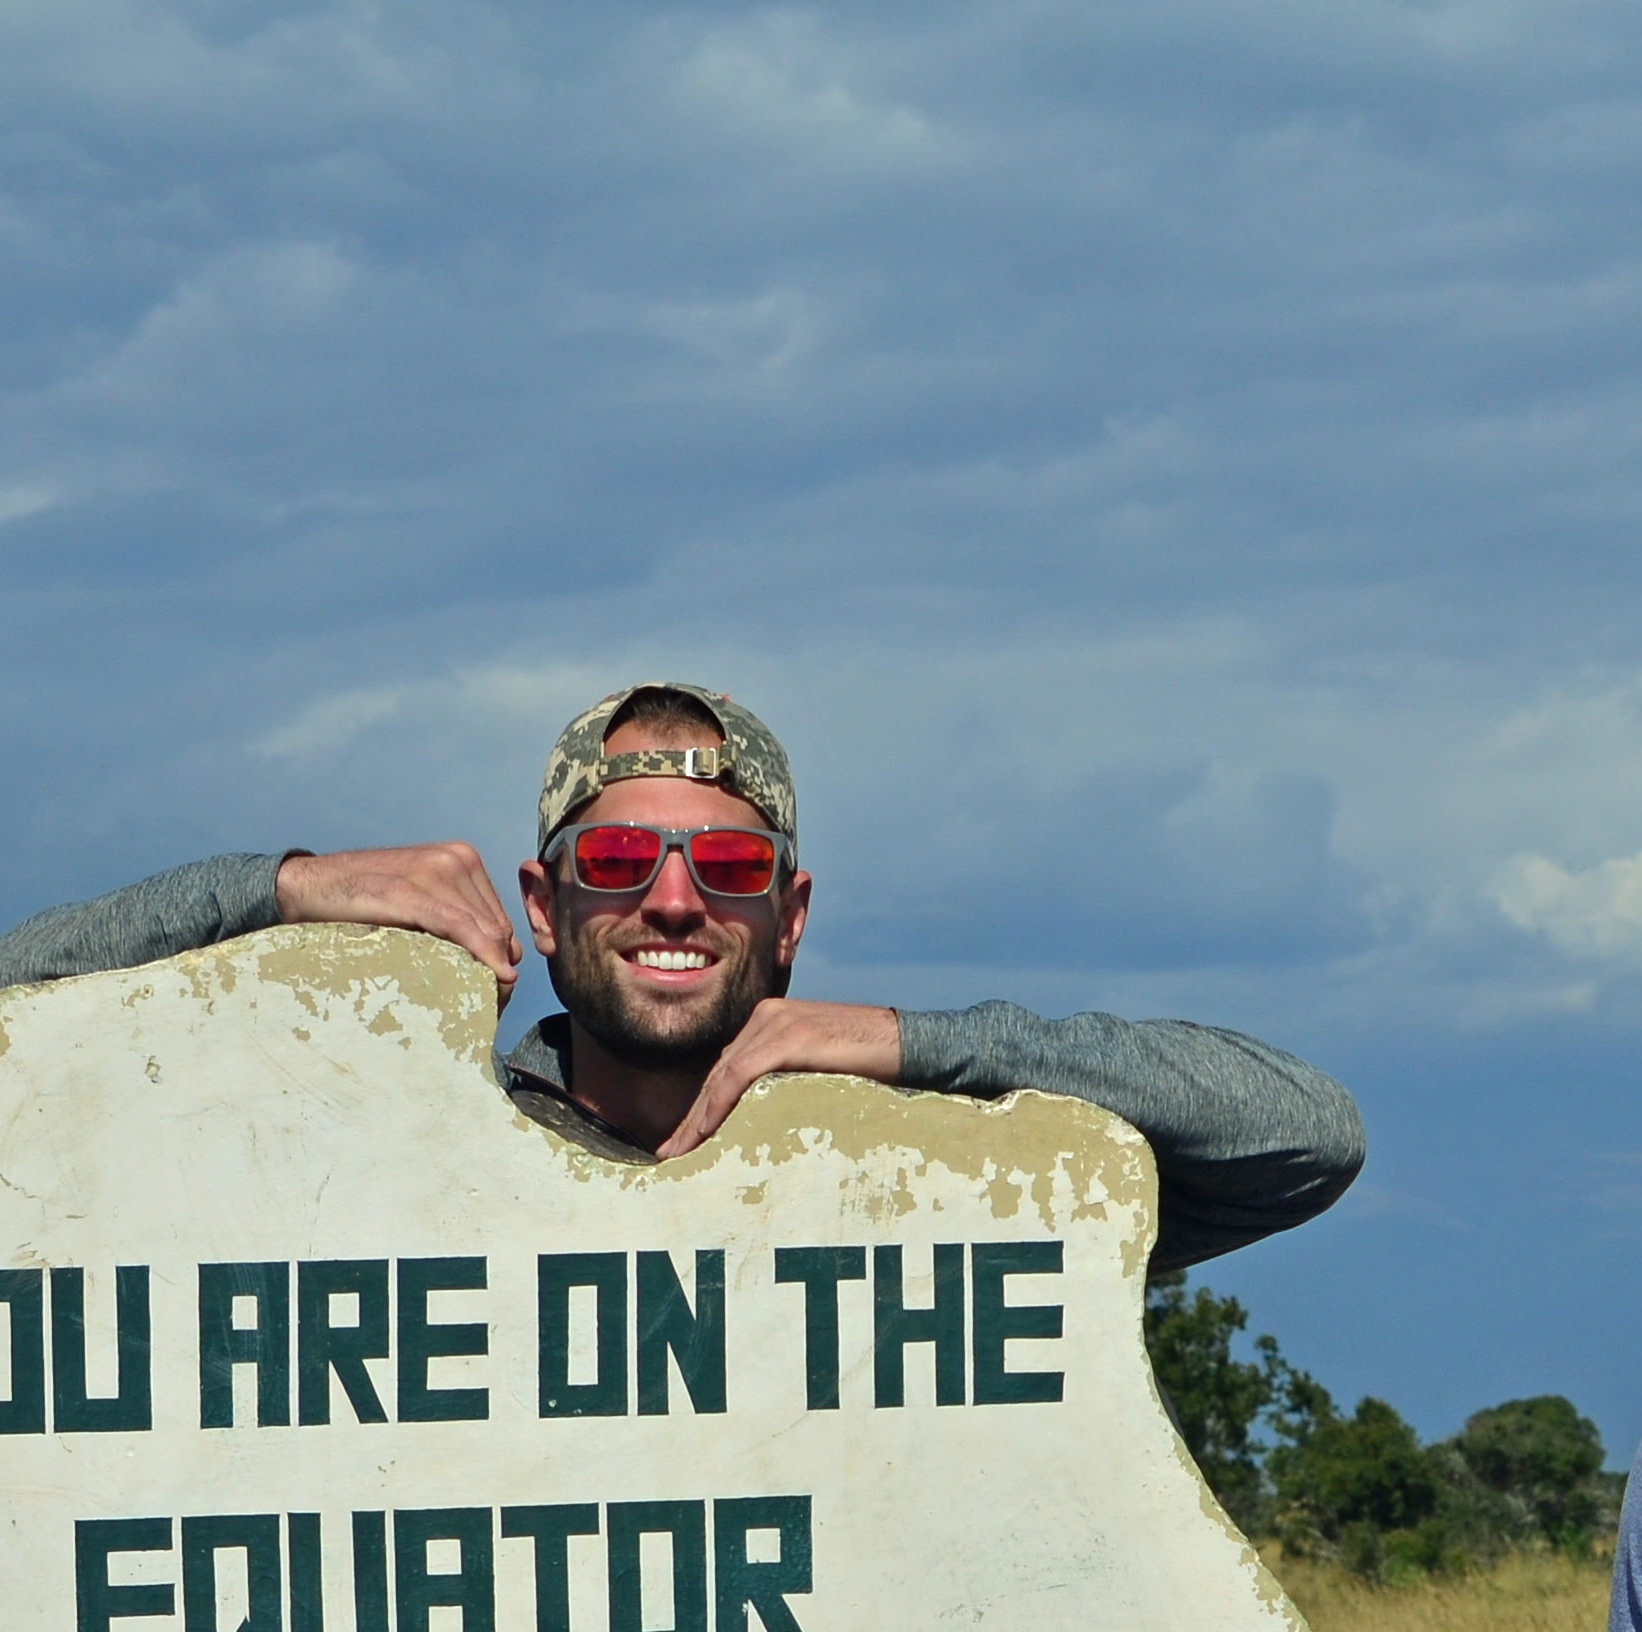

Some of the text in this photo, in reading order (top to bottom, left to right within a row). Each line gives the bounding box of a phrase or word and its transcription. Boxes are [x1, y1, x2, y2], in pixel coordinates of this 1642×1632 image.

[198, 1257, 489, 1430] ARE
[538, 1249, 727, 1418] ON
[775, 1240, 1065, 1410] THE
